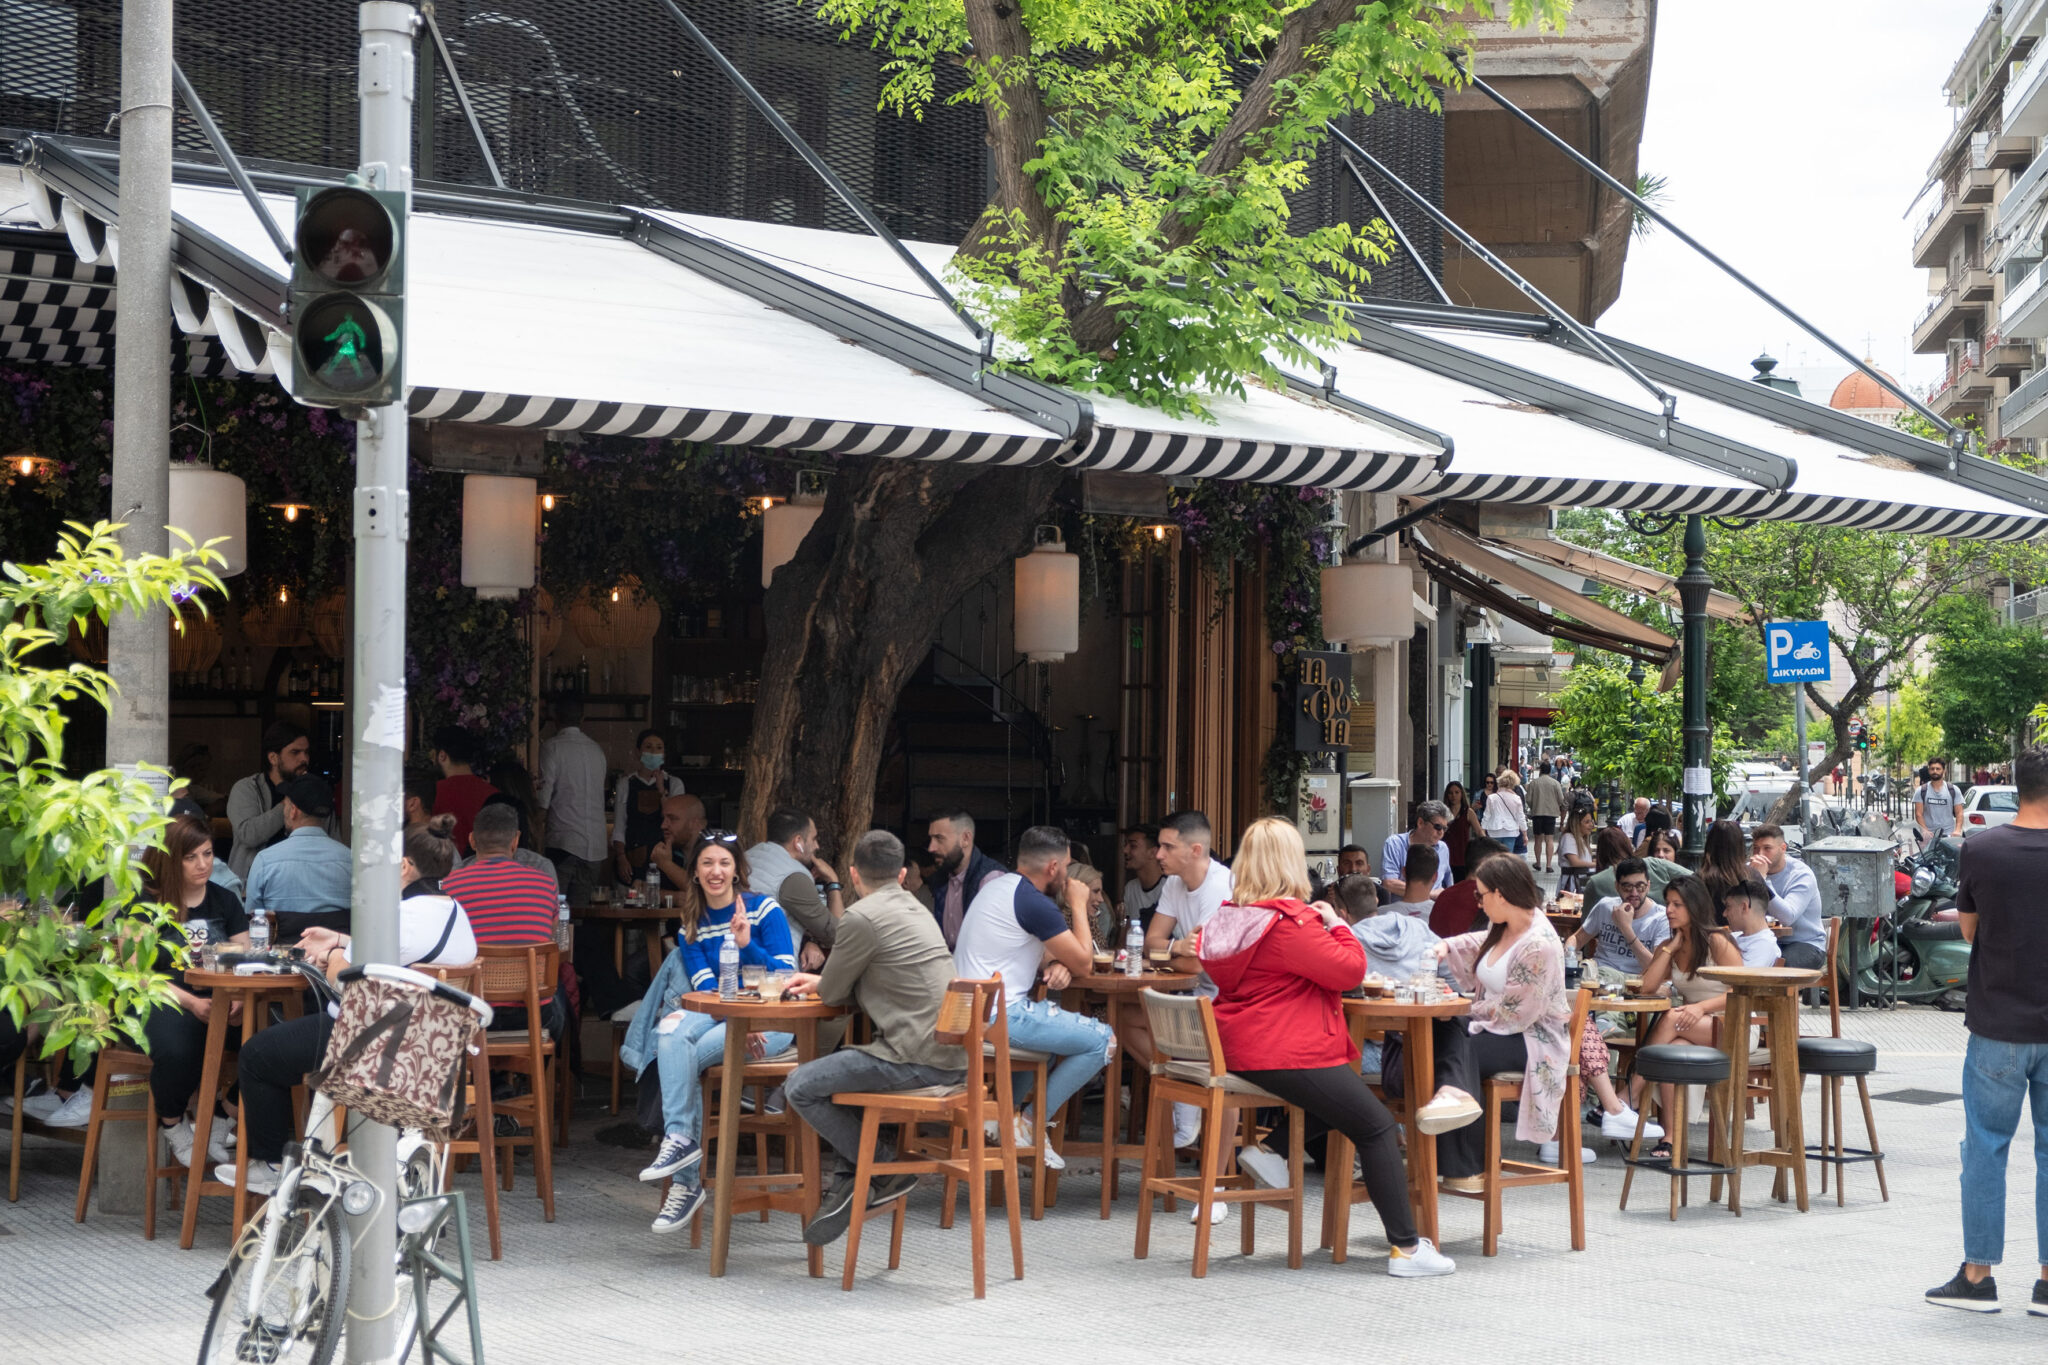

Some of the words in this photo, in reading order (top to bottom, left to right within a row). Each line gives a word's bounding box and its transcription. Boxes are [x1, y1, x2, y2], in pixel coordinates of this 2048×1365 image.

[1770, 629, 1793, 669] P
[1772, 667, 1825, 677] ΔΙΚΥΚΛΩΝ
[1600, 930, 1652, 949] HILFR
[1618, 947, 1636, 958] DE
